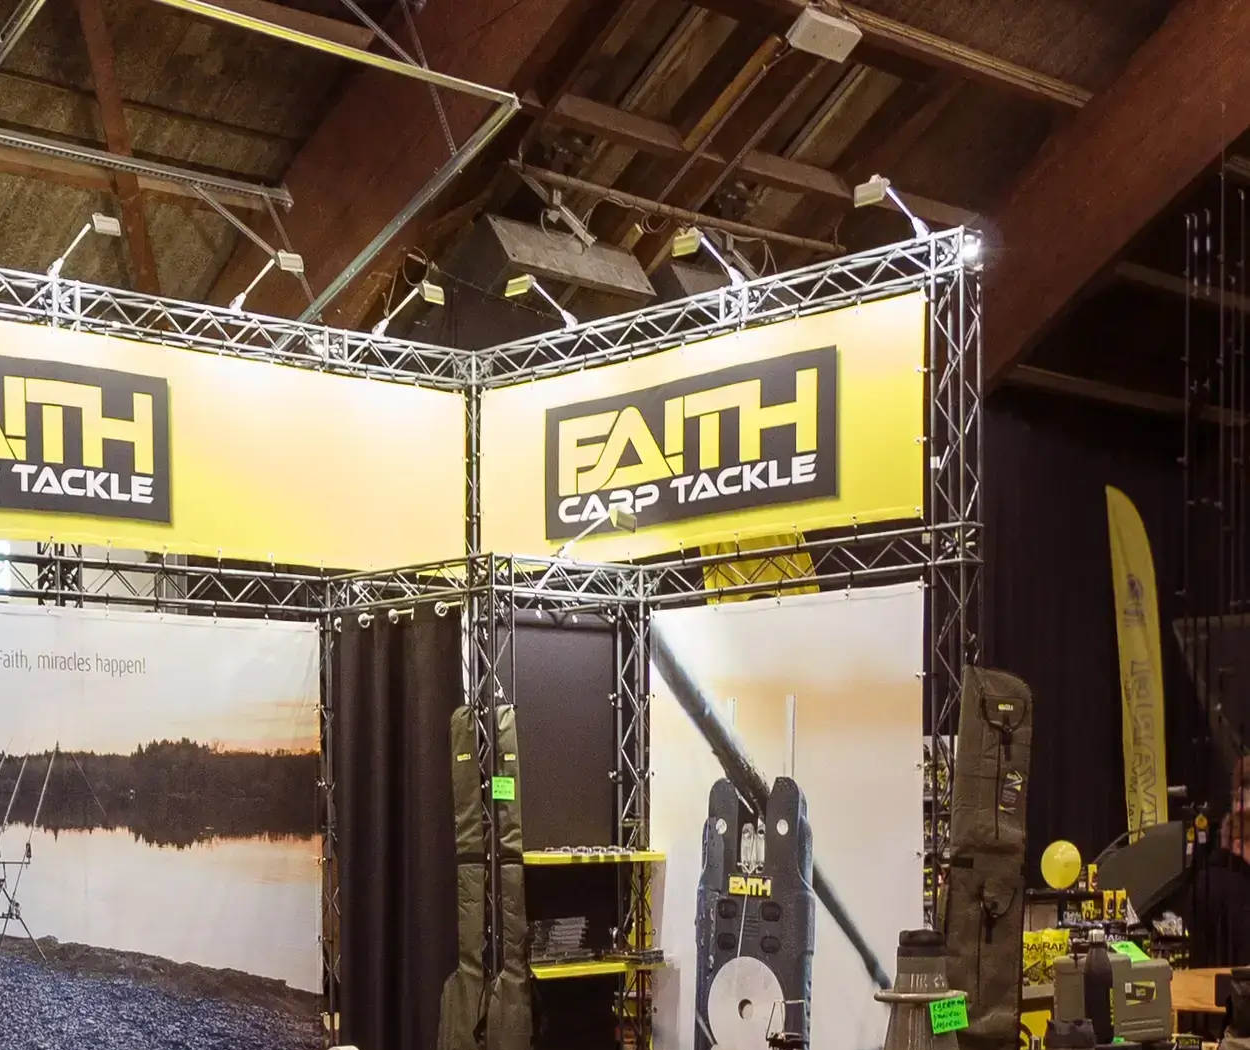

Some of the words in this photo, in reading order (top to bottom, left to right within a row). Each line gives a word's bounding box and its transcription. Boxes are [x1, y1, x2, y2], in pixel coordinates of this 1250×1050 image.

[558, 367, 818, 498] FAITH
[9, 462, 154, 505] TACKLE
[558, 483, 661, 524] CARP
[669, 453, 818, 504] TACKLE
[37, 651, 92, 672] miracles
[95, 652, 146, 677] happen!
[728, 876, 772, 896] FAITH
